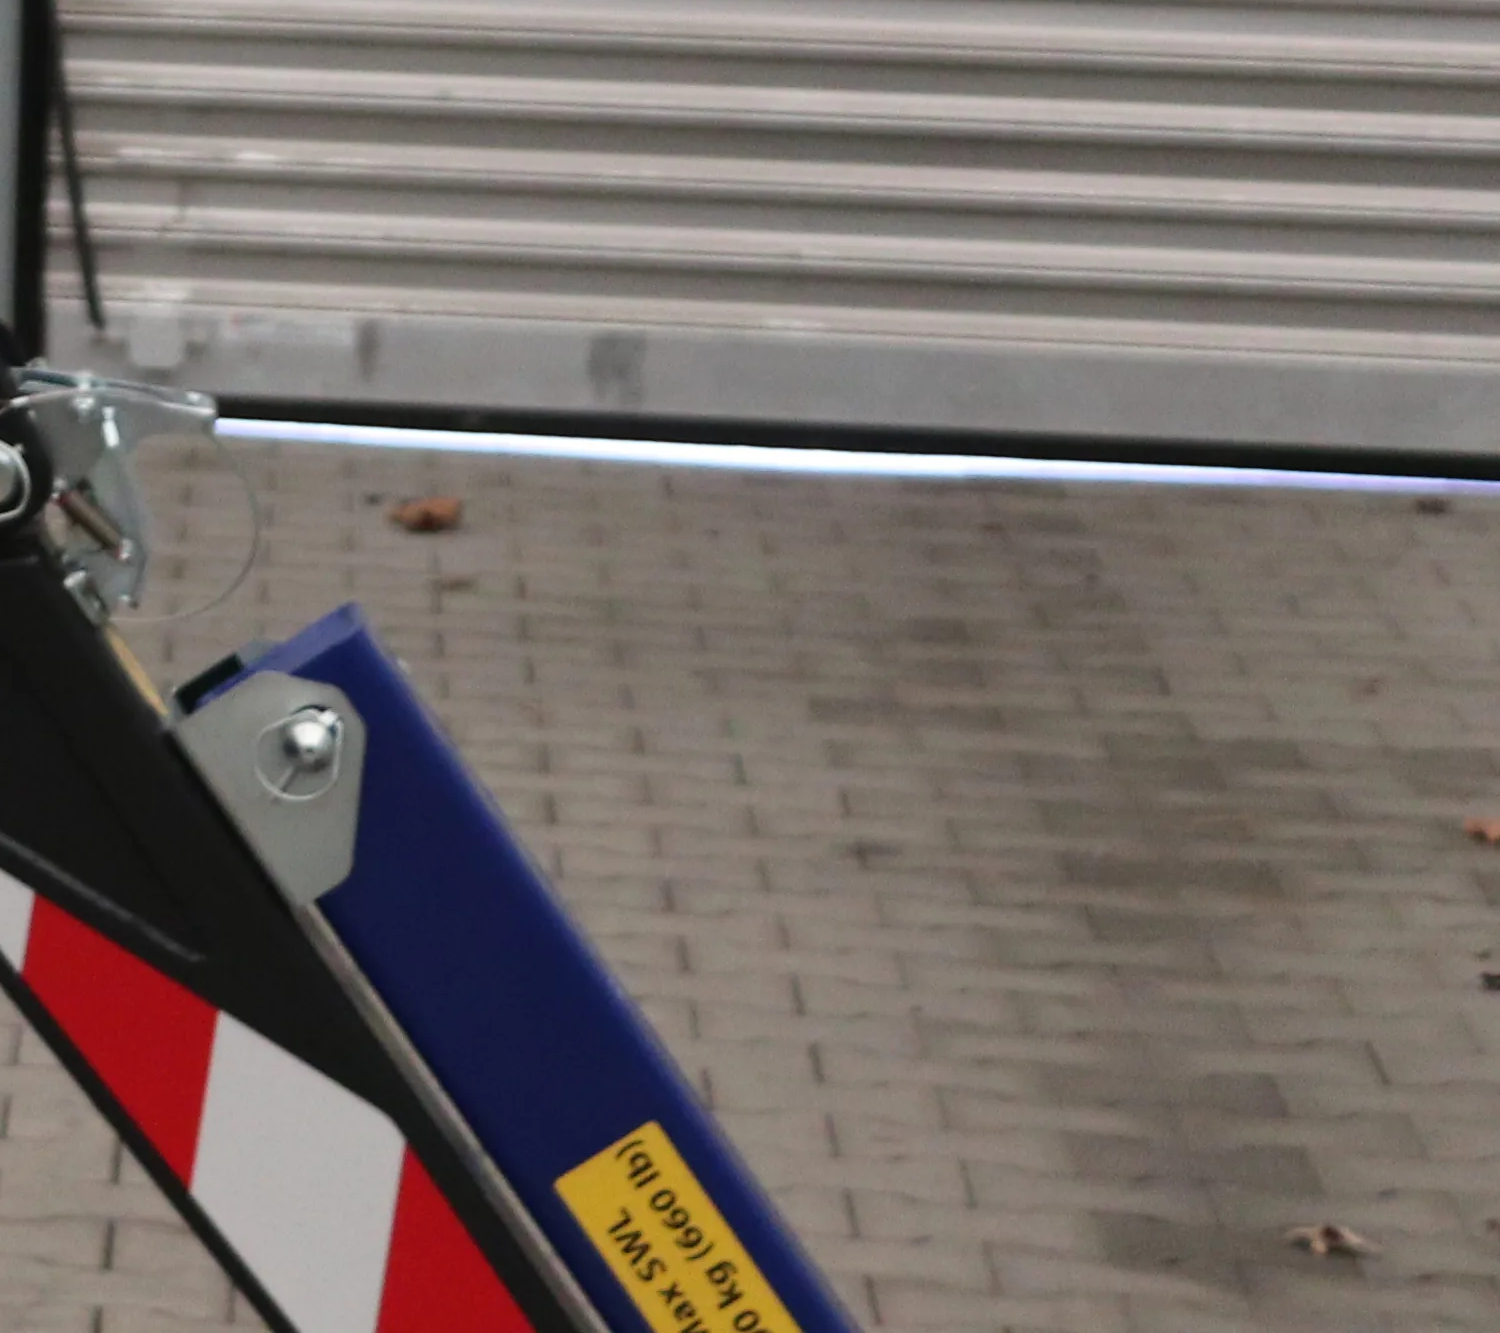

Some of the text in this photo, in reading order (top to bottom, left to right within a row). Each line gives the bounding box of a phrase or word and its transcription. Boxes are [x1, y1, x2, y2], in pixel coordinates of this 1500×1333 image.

[614, 1138, 661, 1190] lb)
[608, 1206, 667, 1282] SWL
[649, 1188, 714, 1262] (660
[704, 1260, 744, 1310] kg
